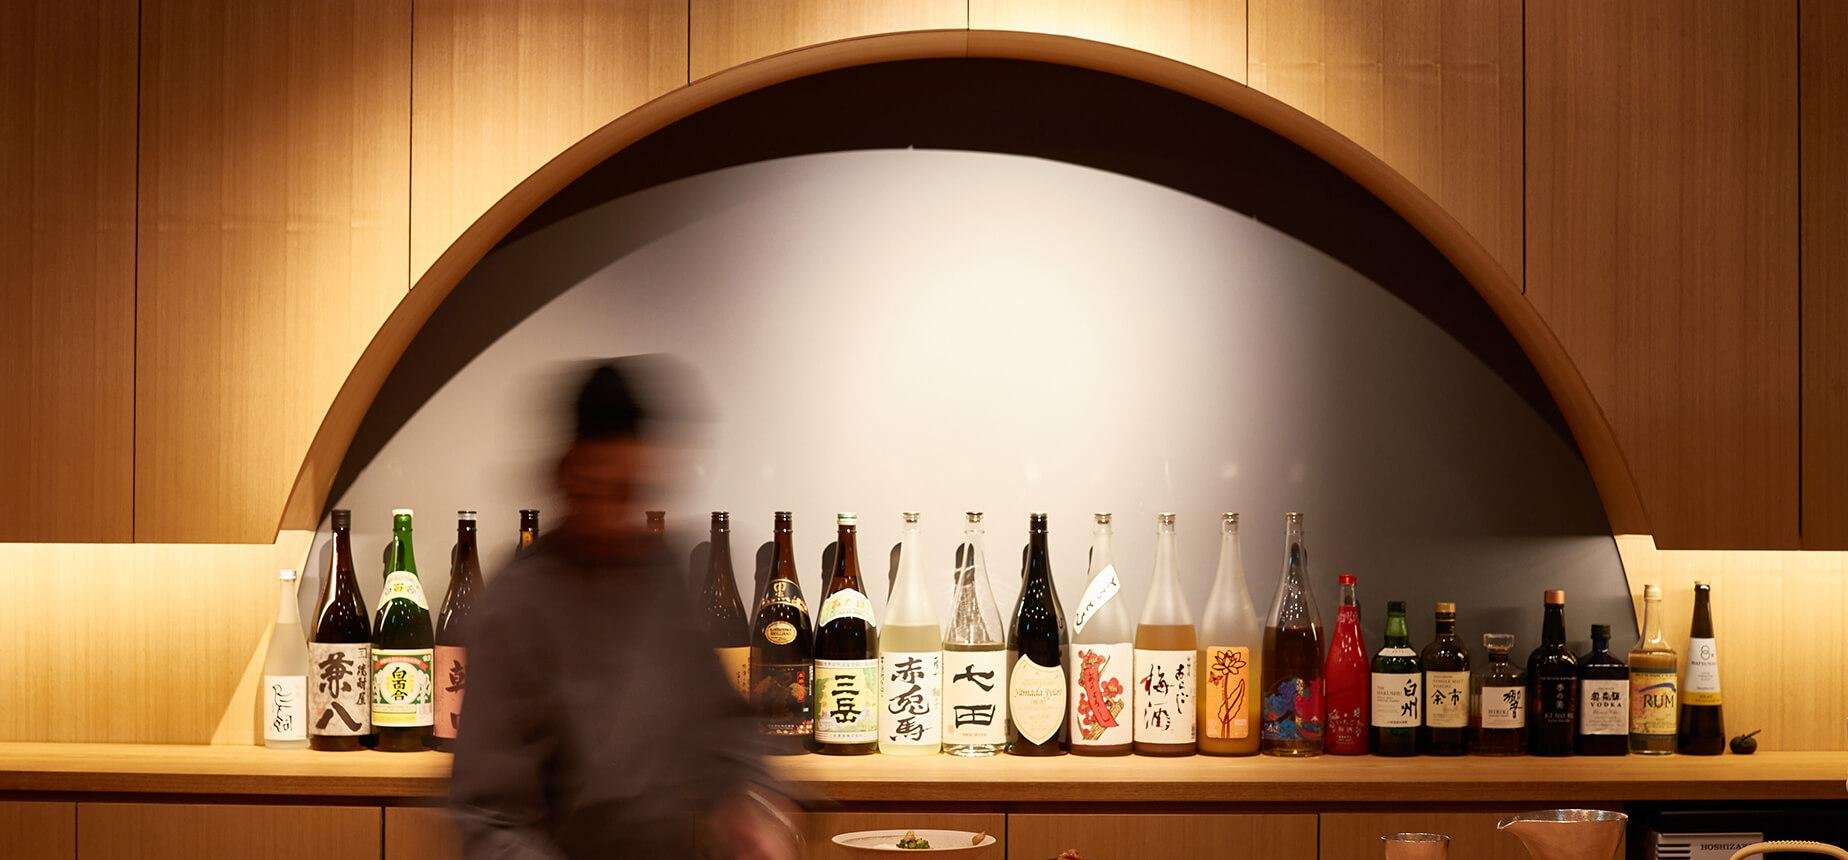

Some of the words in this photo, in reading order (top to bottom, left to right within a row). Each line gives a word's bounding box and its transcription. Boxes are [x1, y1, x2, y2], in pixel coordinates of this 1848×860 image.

[315, 652, 363, 732] 兼八
[391, 666, 408, 701] 白百合
[829, 674, 861, 723] 三岳
[952, 664, 996, 728] 七田
[1142, 664, 1173, 730] 梅酒
[1401, 679, 1418, 719] 白州
[1431, 688, 1462, 706] 余市
[1643, 694, 1675, 708] RUM
[1701, 843, 1752, 851] HOSHIZA
